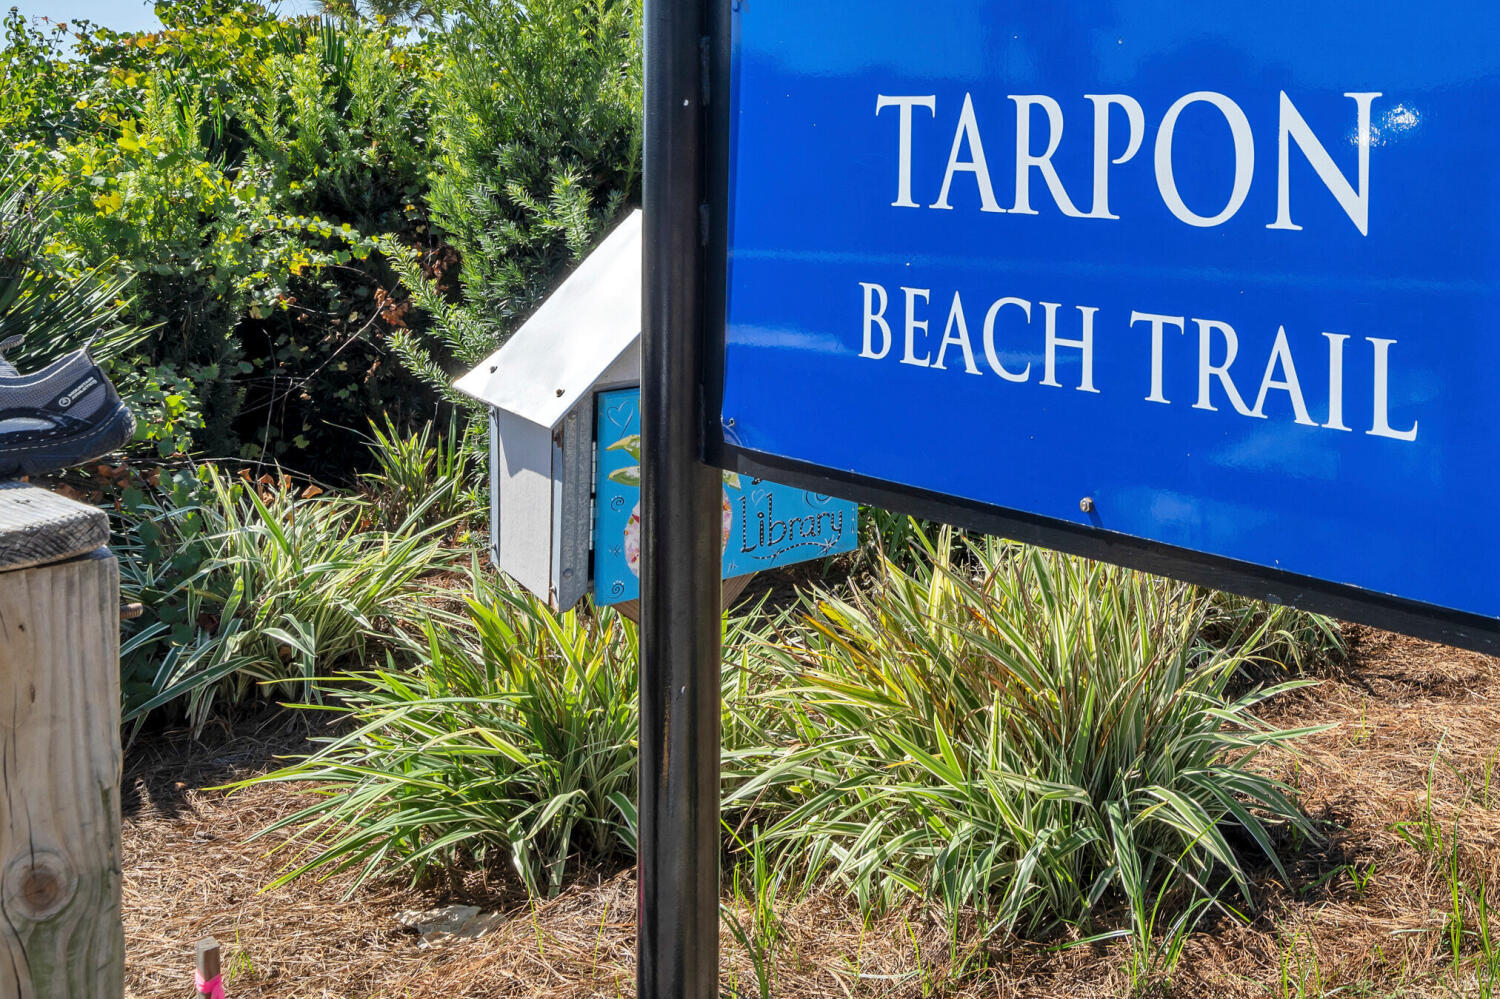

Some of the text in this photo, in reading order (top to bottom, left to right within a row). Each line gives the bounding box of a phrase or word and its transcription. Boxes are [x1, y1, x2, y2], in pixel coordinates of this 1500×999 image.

[875, 89, 1383, 237] TARPON
[858, 281, 1418, 442] BEACH TRAIL
[738, 492, 843, 553] Library
